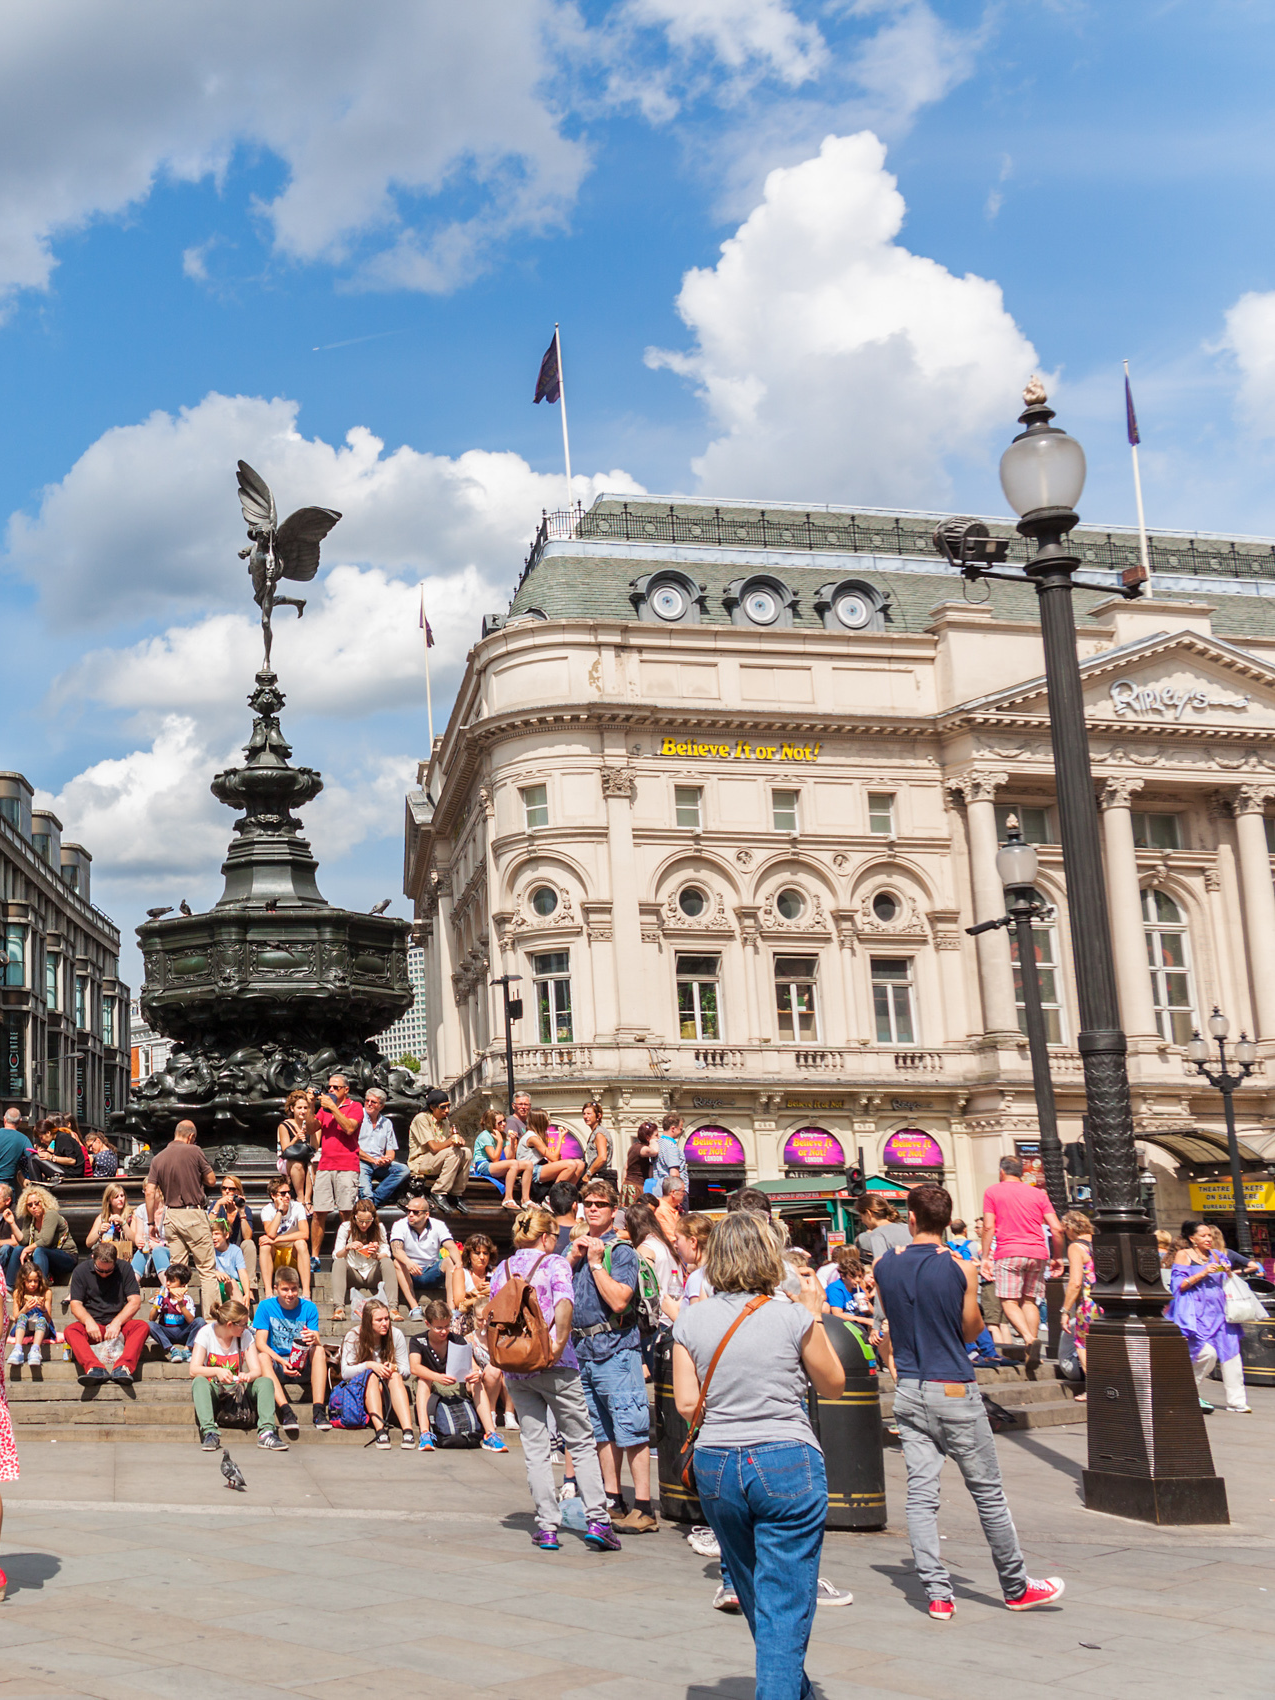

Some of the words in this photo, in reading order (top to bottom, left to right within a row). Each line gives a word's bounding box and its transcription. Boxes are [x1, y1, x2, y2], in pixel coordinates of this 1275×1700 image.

[660, 737, 729, 757] Believe
[734, 740, 752, 758] It
[755, 745, 776, 760] or
[780, 742, 821, 761] Not!
[692, 1136, 723, 1146] Believe
[725, 1136, 733, 1146] It
[792, 1138, 823, 1147] Believe
[824, 1138, 833, 1147] It
[891, 1139, 922, 1148] Believe
[923, 1140, 932, 1148] It
[698, 1148, 708, 1156] or
[709, 1146, 727, 1155] Not!
[809, 1148, 827, 1156] Not!
